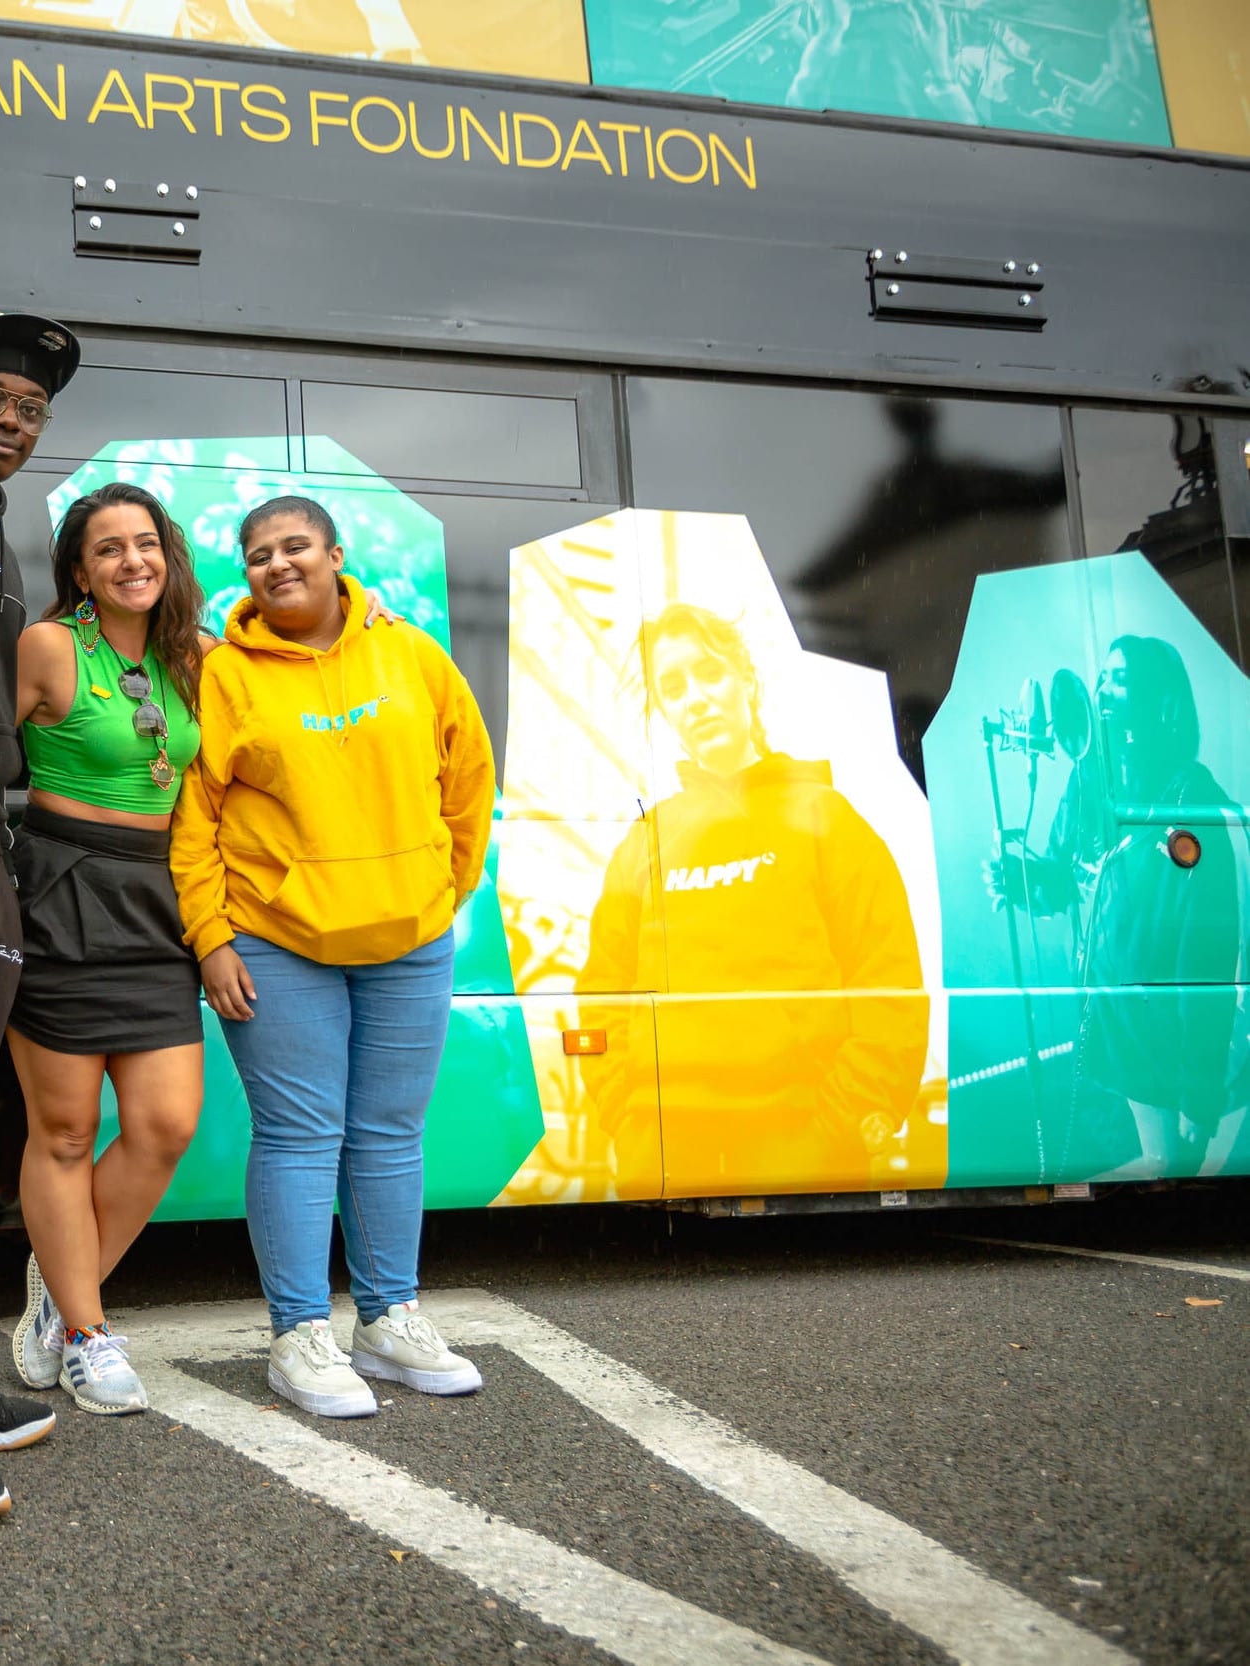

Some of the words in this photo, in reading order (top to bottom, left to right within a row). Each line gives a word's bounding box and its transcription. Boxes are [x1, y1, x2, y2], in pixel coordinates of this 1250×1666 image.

[88, 69, 291, 143] ARTS
[309, 90, 757, 189] FOUNDATION
[664, 856, 761, 892] HAPPY
